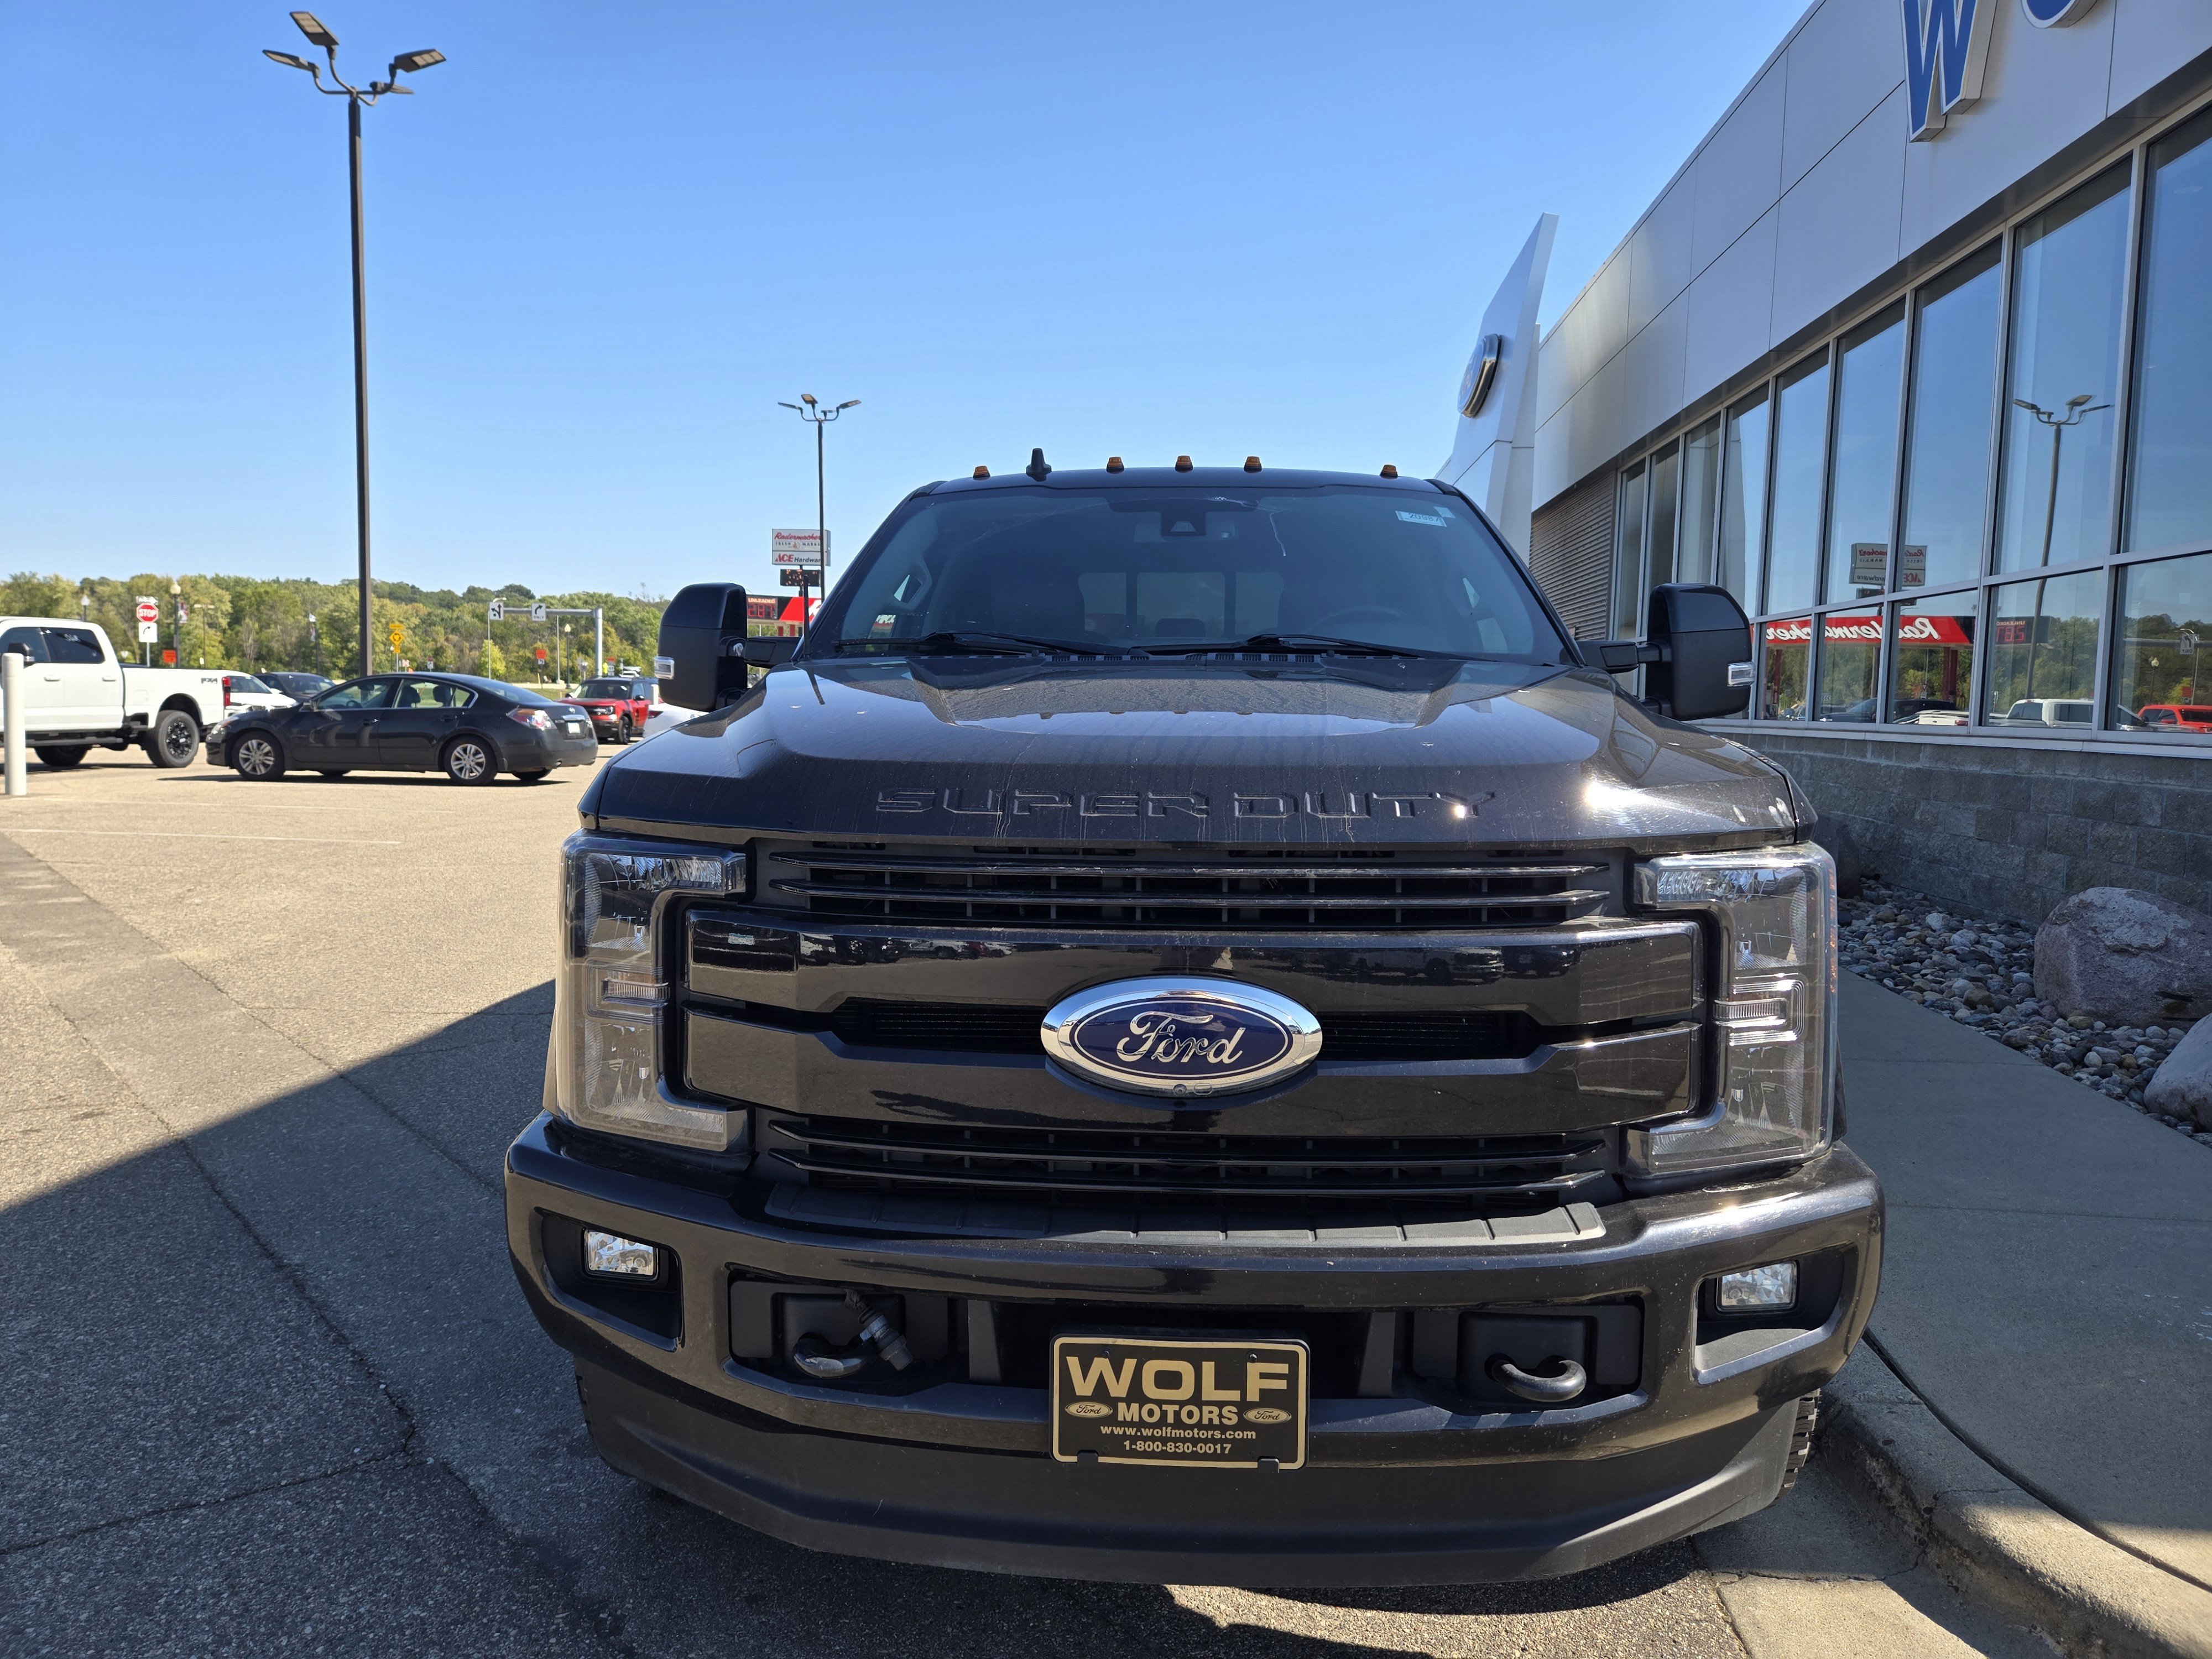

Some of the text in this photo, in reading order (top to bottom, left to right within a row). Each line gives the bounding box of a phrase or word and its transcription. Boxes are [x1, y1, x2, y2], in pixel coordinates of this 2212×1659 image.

[775, 553, 794, 562] ACE
[138, 608, 156, 617] STOP
[876, 789, 1495, 818] SUPER DUTY
[1117, 1011, 1246, 1064] Ford
[1066, 1356, 1289, 1402] WOLF
[1076, 1404, 1102, 1416] Ford
[1117, 1402, 1239, 1425] MOTORS
[1254, 1410, 1280, 1421] Ford
[1100, 1425, 1256, 1439] www.wolfmotors.com
[1123, 1440, 1232, 1454] 1-800-830-0017
